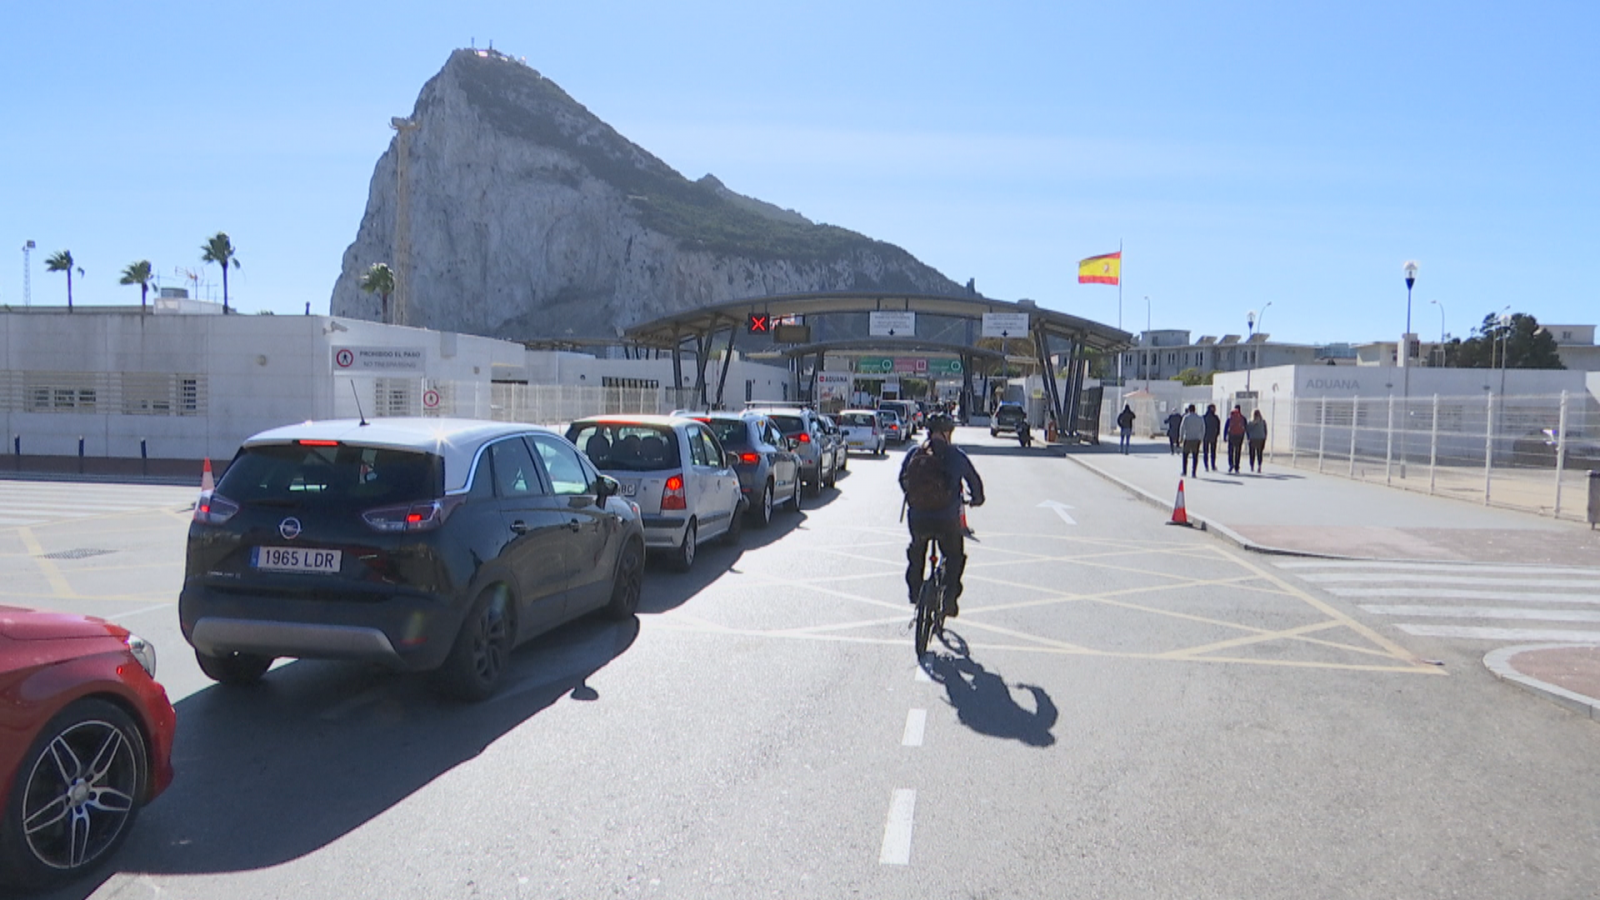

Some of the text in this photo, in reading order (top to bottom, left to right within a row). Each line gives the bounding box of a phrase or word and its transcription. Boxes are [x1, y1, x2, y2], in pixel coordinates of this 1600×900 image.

[1306, 379, 1360, 390] ADUANA
[265, 550, 334, 568] 1965 LDR
